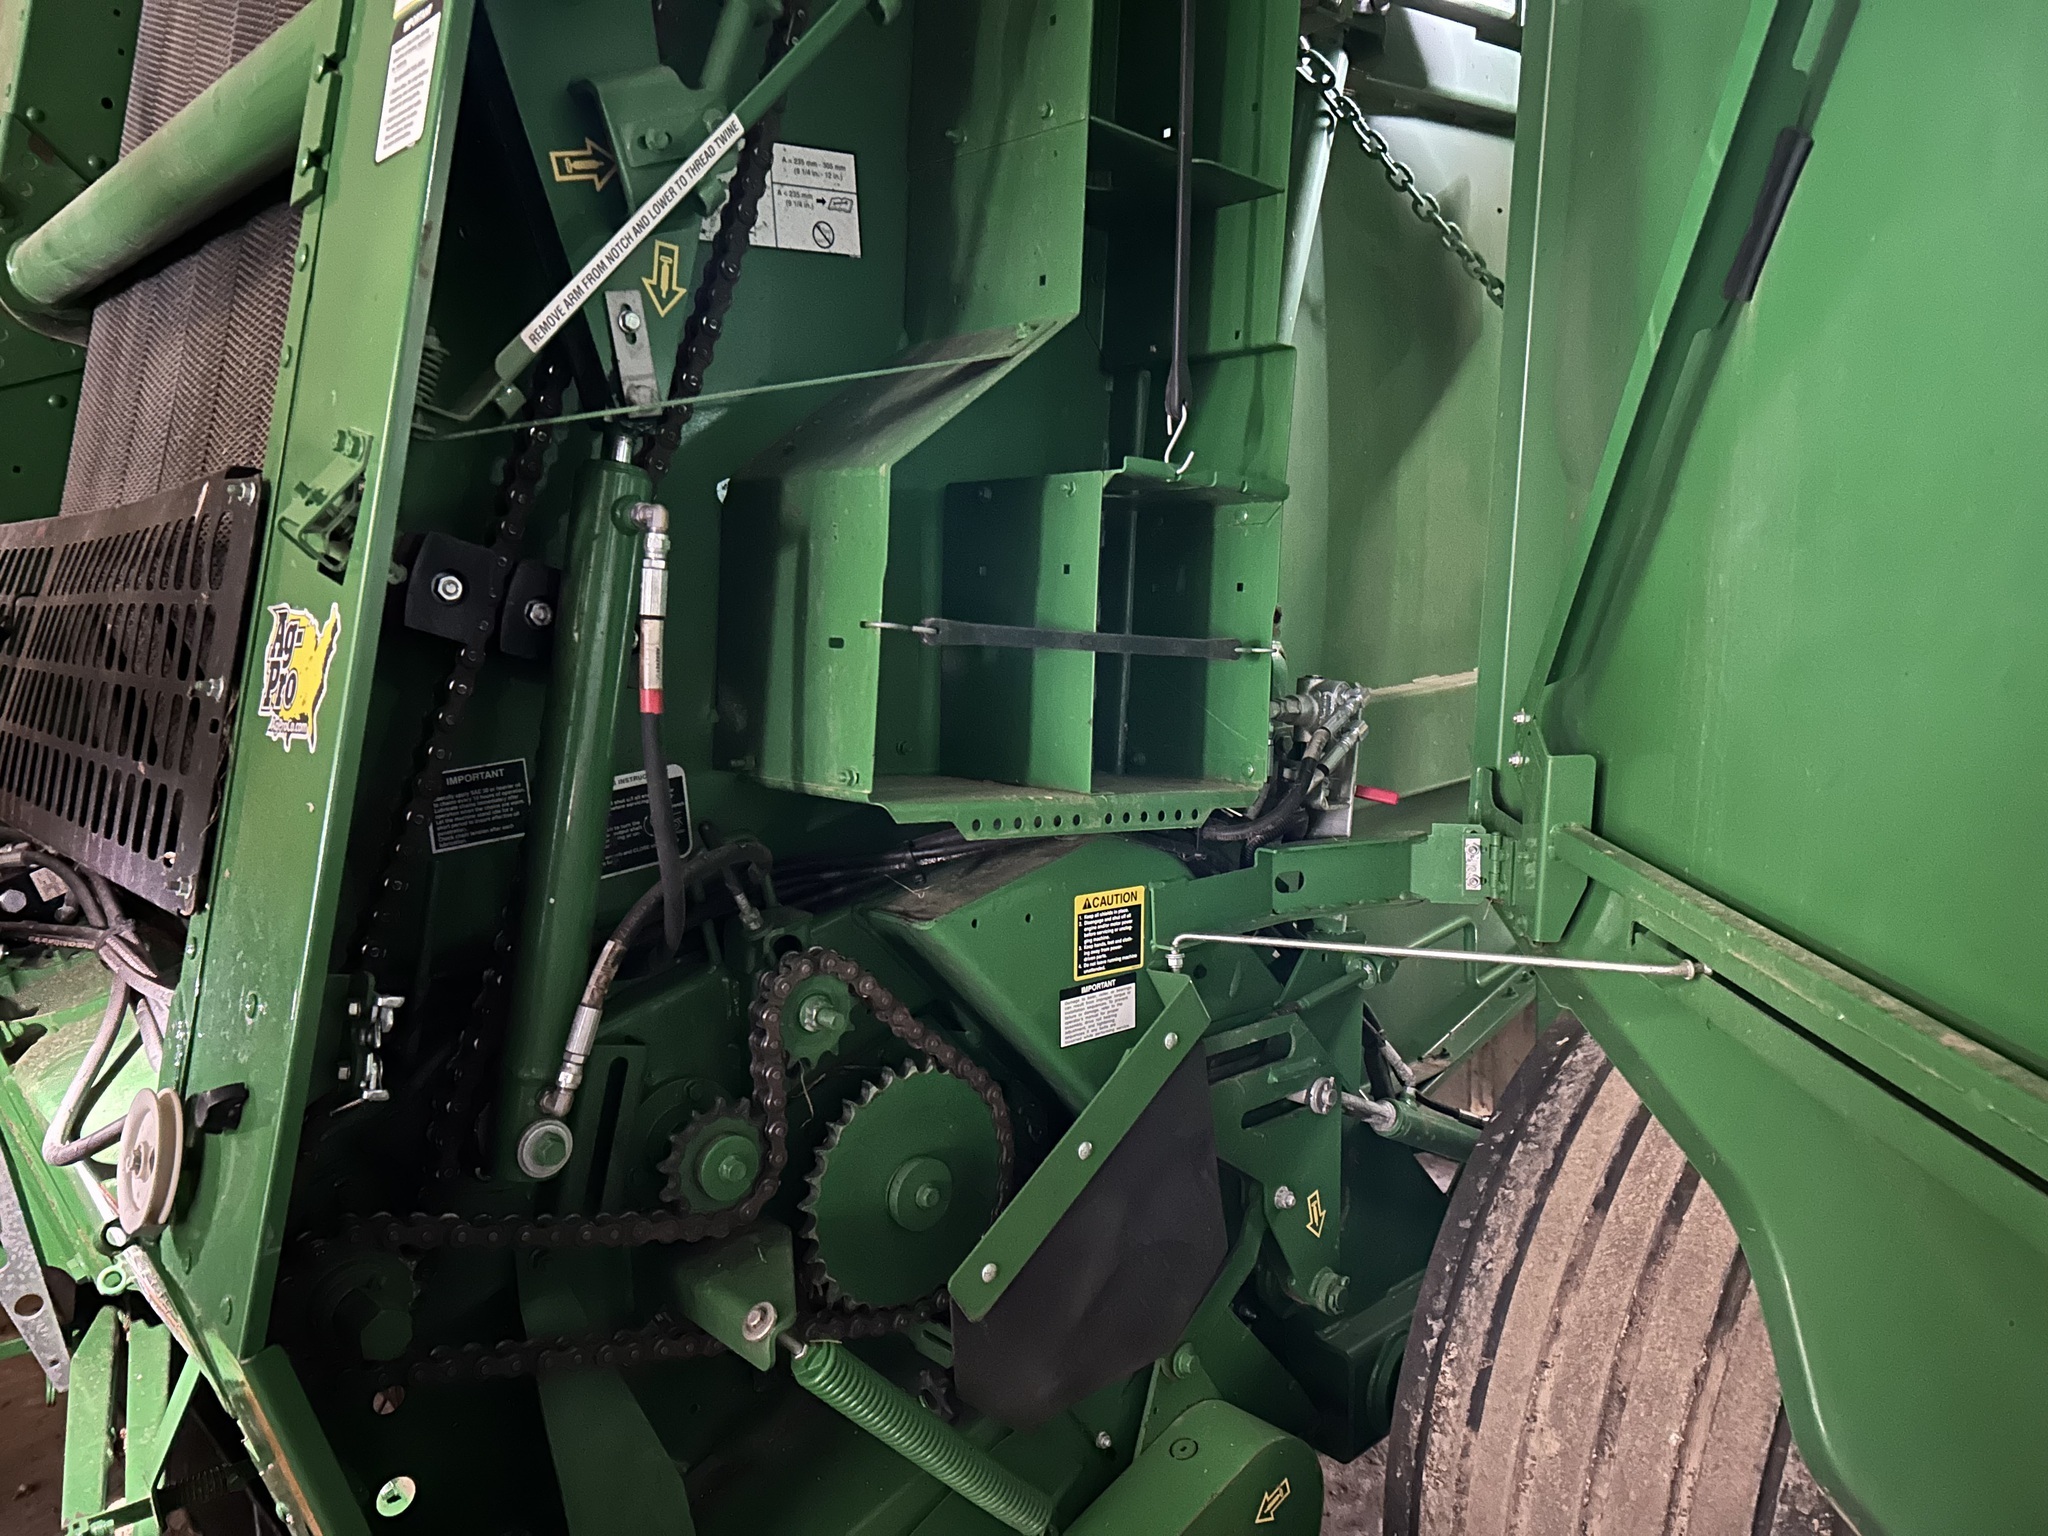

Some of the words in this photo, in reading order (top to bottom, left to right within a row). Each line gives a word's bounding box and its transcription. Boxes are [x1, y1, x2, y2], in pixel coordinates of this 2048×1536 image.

[528, 304, 566, 346] REMOVE
[563, 285, 585, 311] ARM
[581, 260, 609, 290] FROM
[605, 232, 634, 265] NOTCH
[631, 215, 651, 238] AND
[648, 186, 678, 220] LOWER
[674, 175, 688, 191] TO
[685, 145, 716, 179] THREAD
[714, 121, 739, 149] TWINE
[270, 612, 306, 670] Ag-
[261, 660, 298, 711] Pro
[446, 768, 504, 785] IMPORTANT
[1092, 891, 1137, 908] CAUTION
[1081, 979, 1116, 993] IMPORTANT
